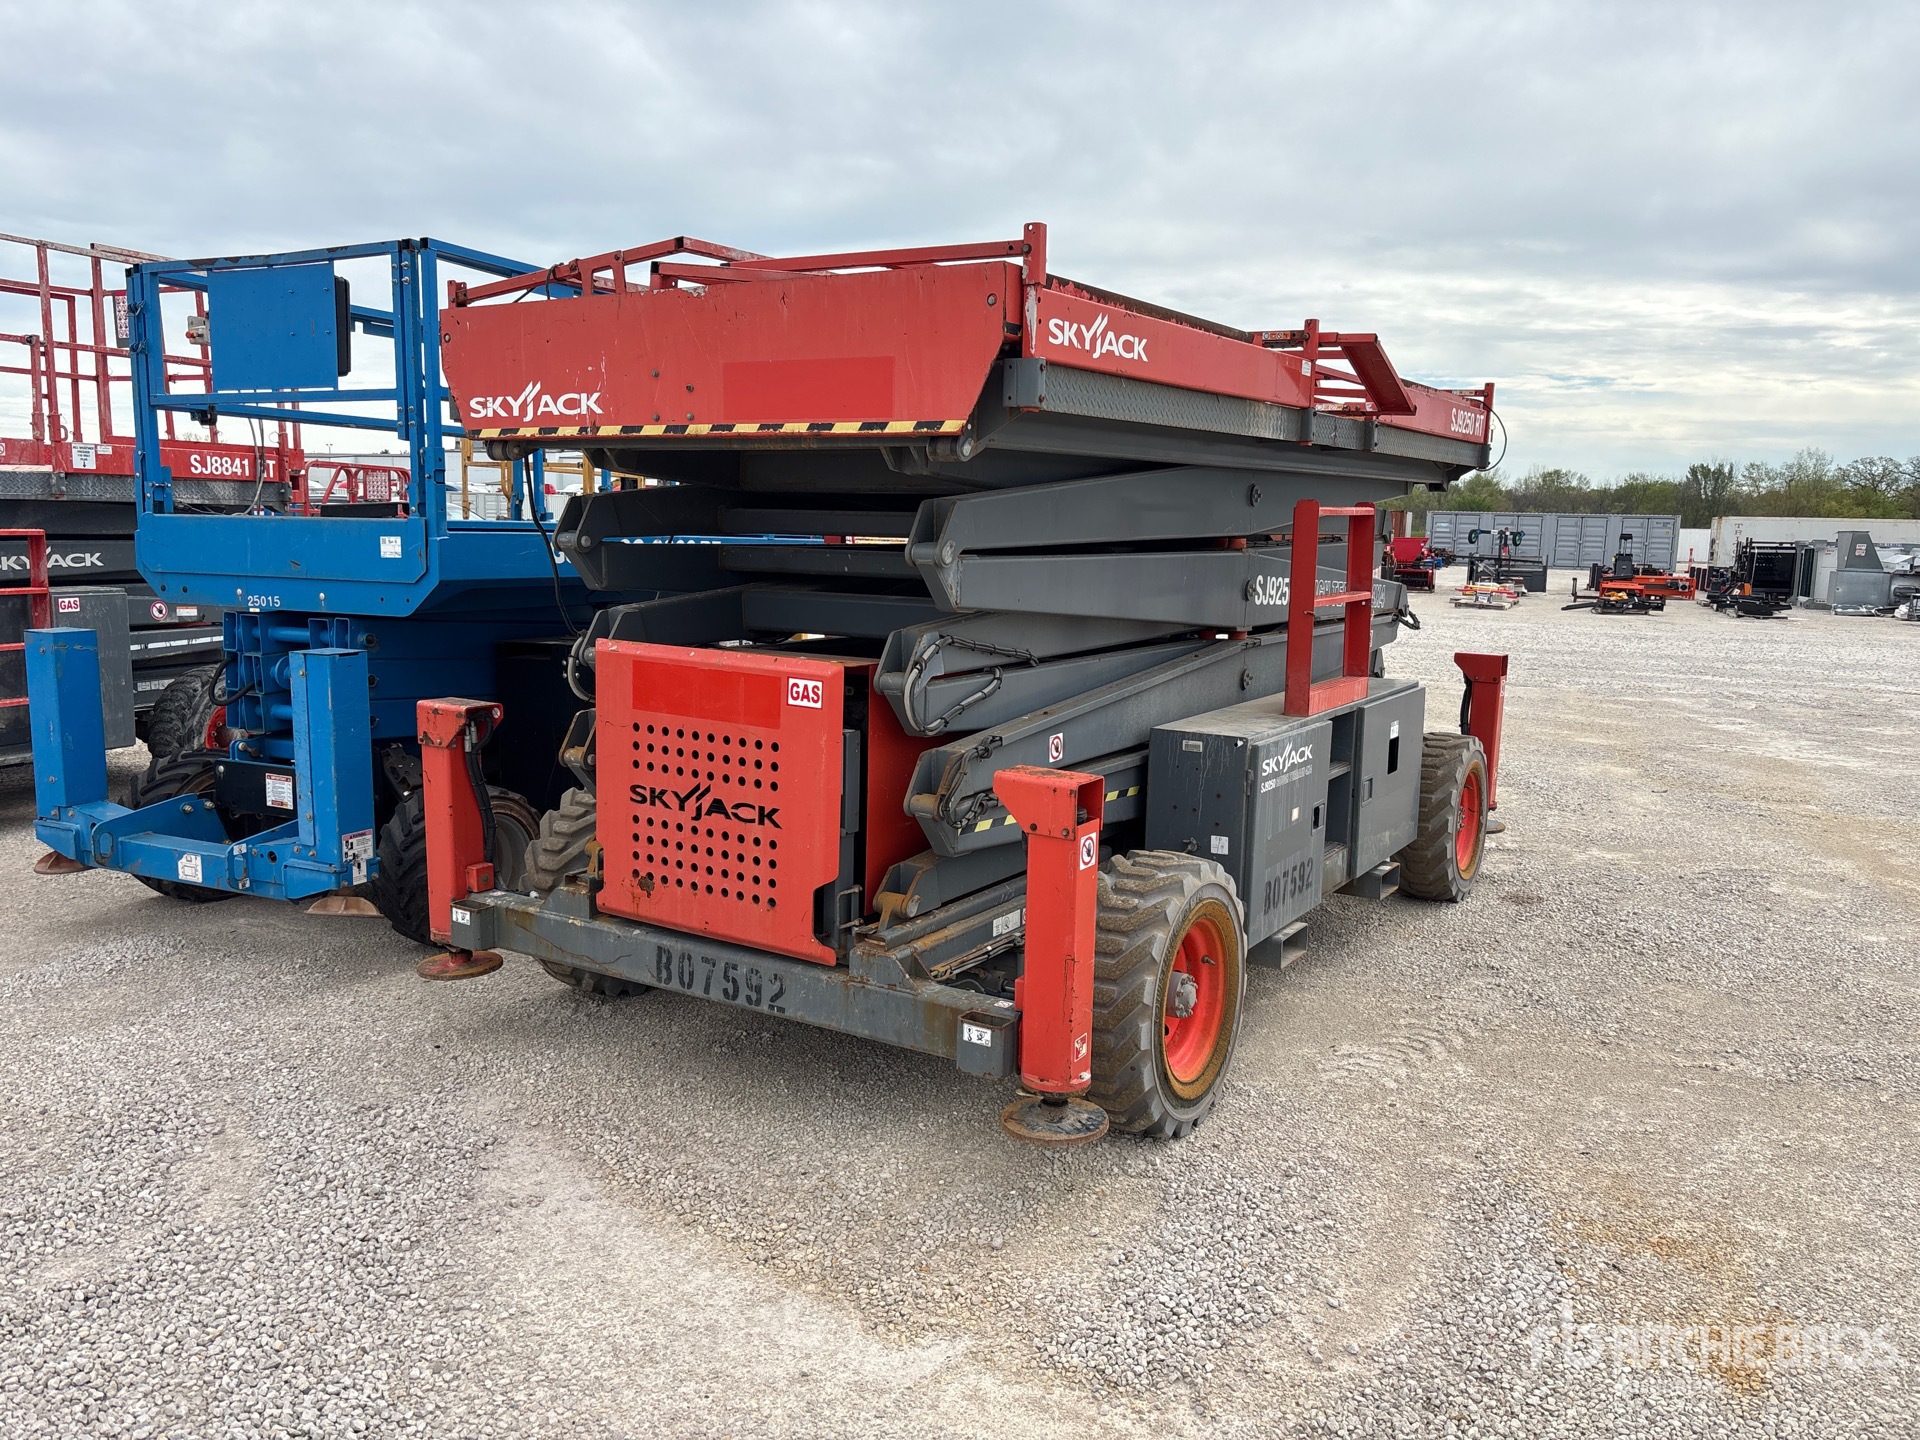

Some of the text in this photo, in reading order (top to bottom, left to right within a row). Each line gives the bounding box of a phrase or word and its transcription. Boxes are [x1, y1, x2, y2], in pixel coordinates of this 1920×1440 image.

[1048, 312, 1148, 362] SKYJACK
[469, 380, 604, 422] SKYJACK
[1451, 408, 1484, 437] SJ9250 RT
[190, 454, 249, 476] SJ8841
[0, 545, 104, 571] KYACK
[59, 599, 79, 611] GAS
[247, 595, 281, 608] 25015
[1254, 574, 1289, 605] SJ925
[790, 682, 821, 704] GAS
[1261, 740, 1313, 777] SKYJACK
[629, 782, 782, 829] SKYJACK
[1263, 856, 1314, 916] B07592
[656, 945, 786, 1014] B07592
